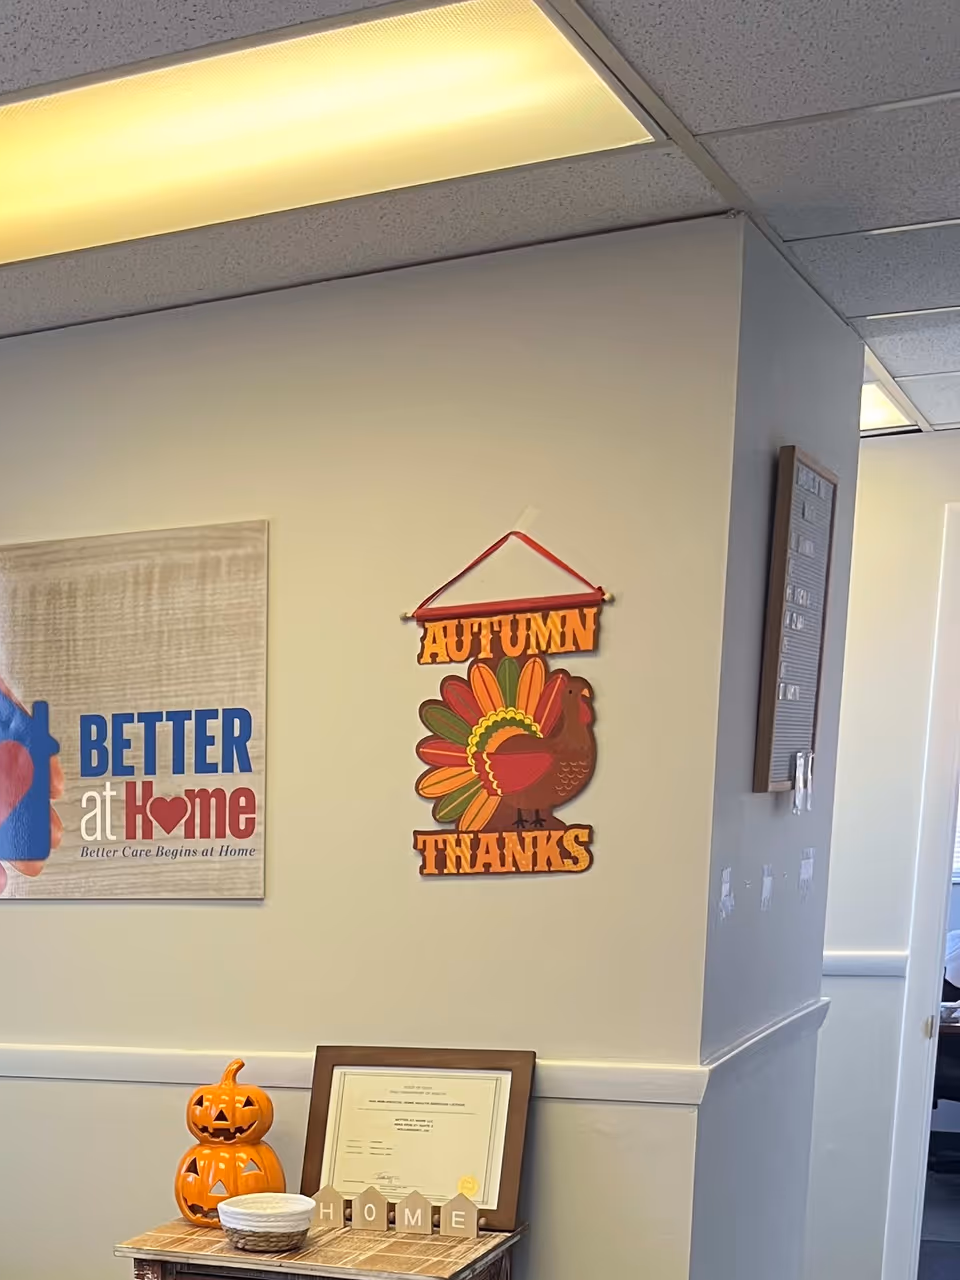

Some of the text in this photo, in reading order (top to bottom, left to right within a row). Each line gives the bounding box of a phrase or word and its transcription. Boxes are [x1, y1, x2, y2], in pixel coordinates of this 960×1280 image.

[420, 608, 598, 664] AUTUMN
[80, 707, 253, 777] BETTER
[80, 781, 117, 841] at
[80, 844, 256, 860] Better Care Begins at Home
[417, 828, 591, 875] THANKS
